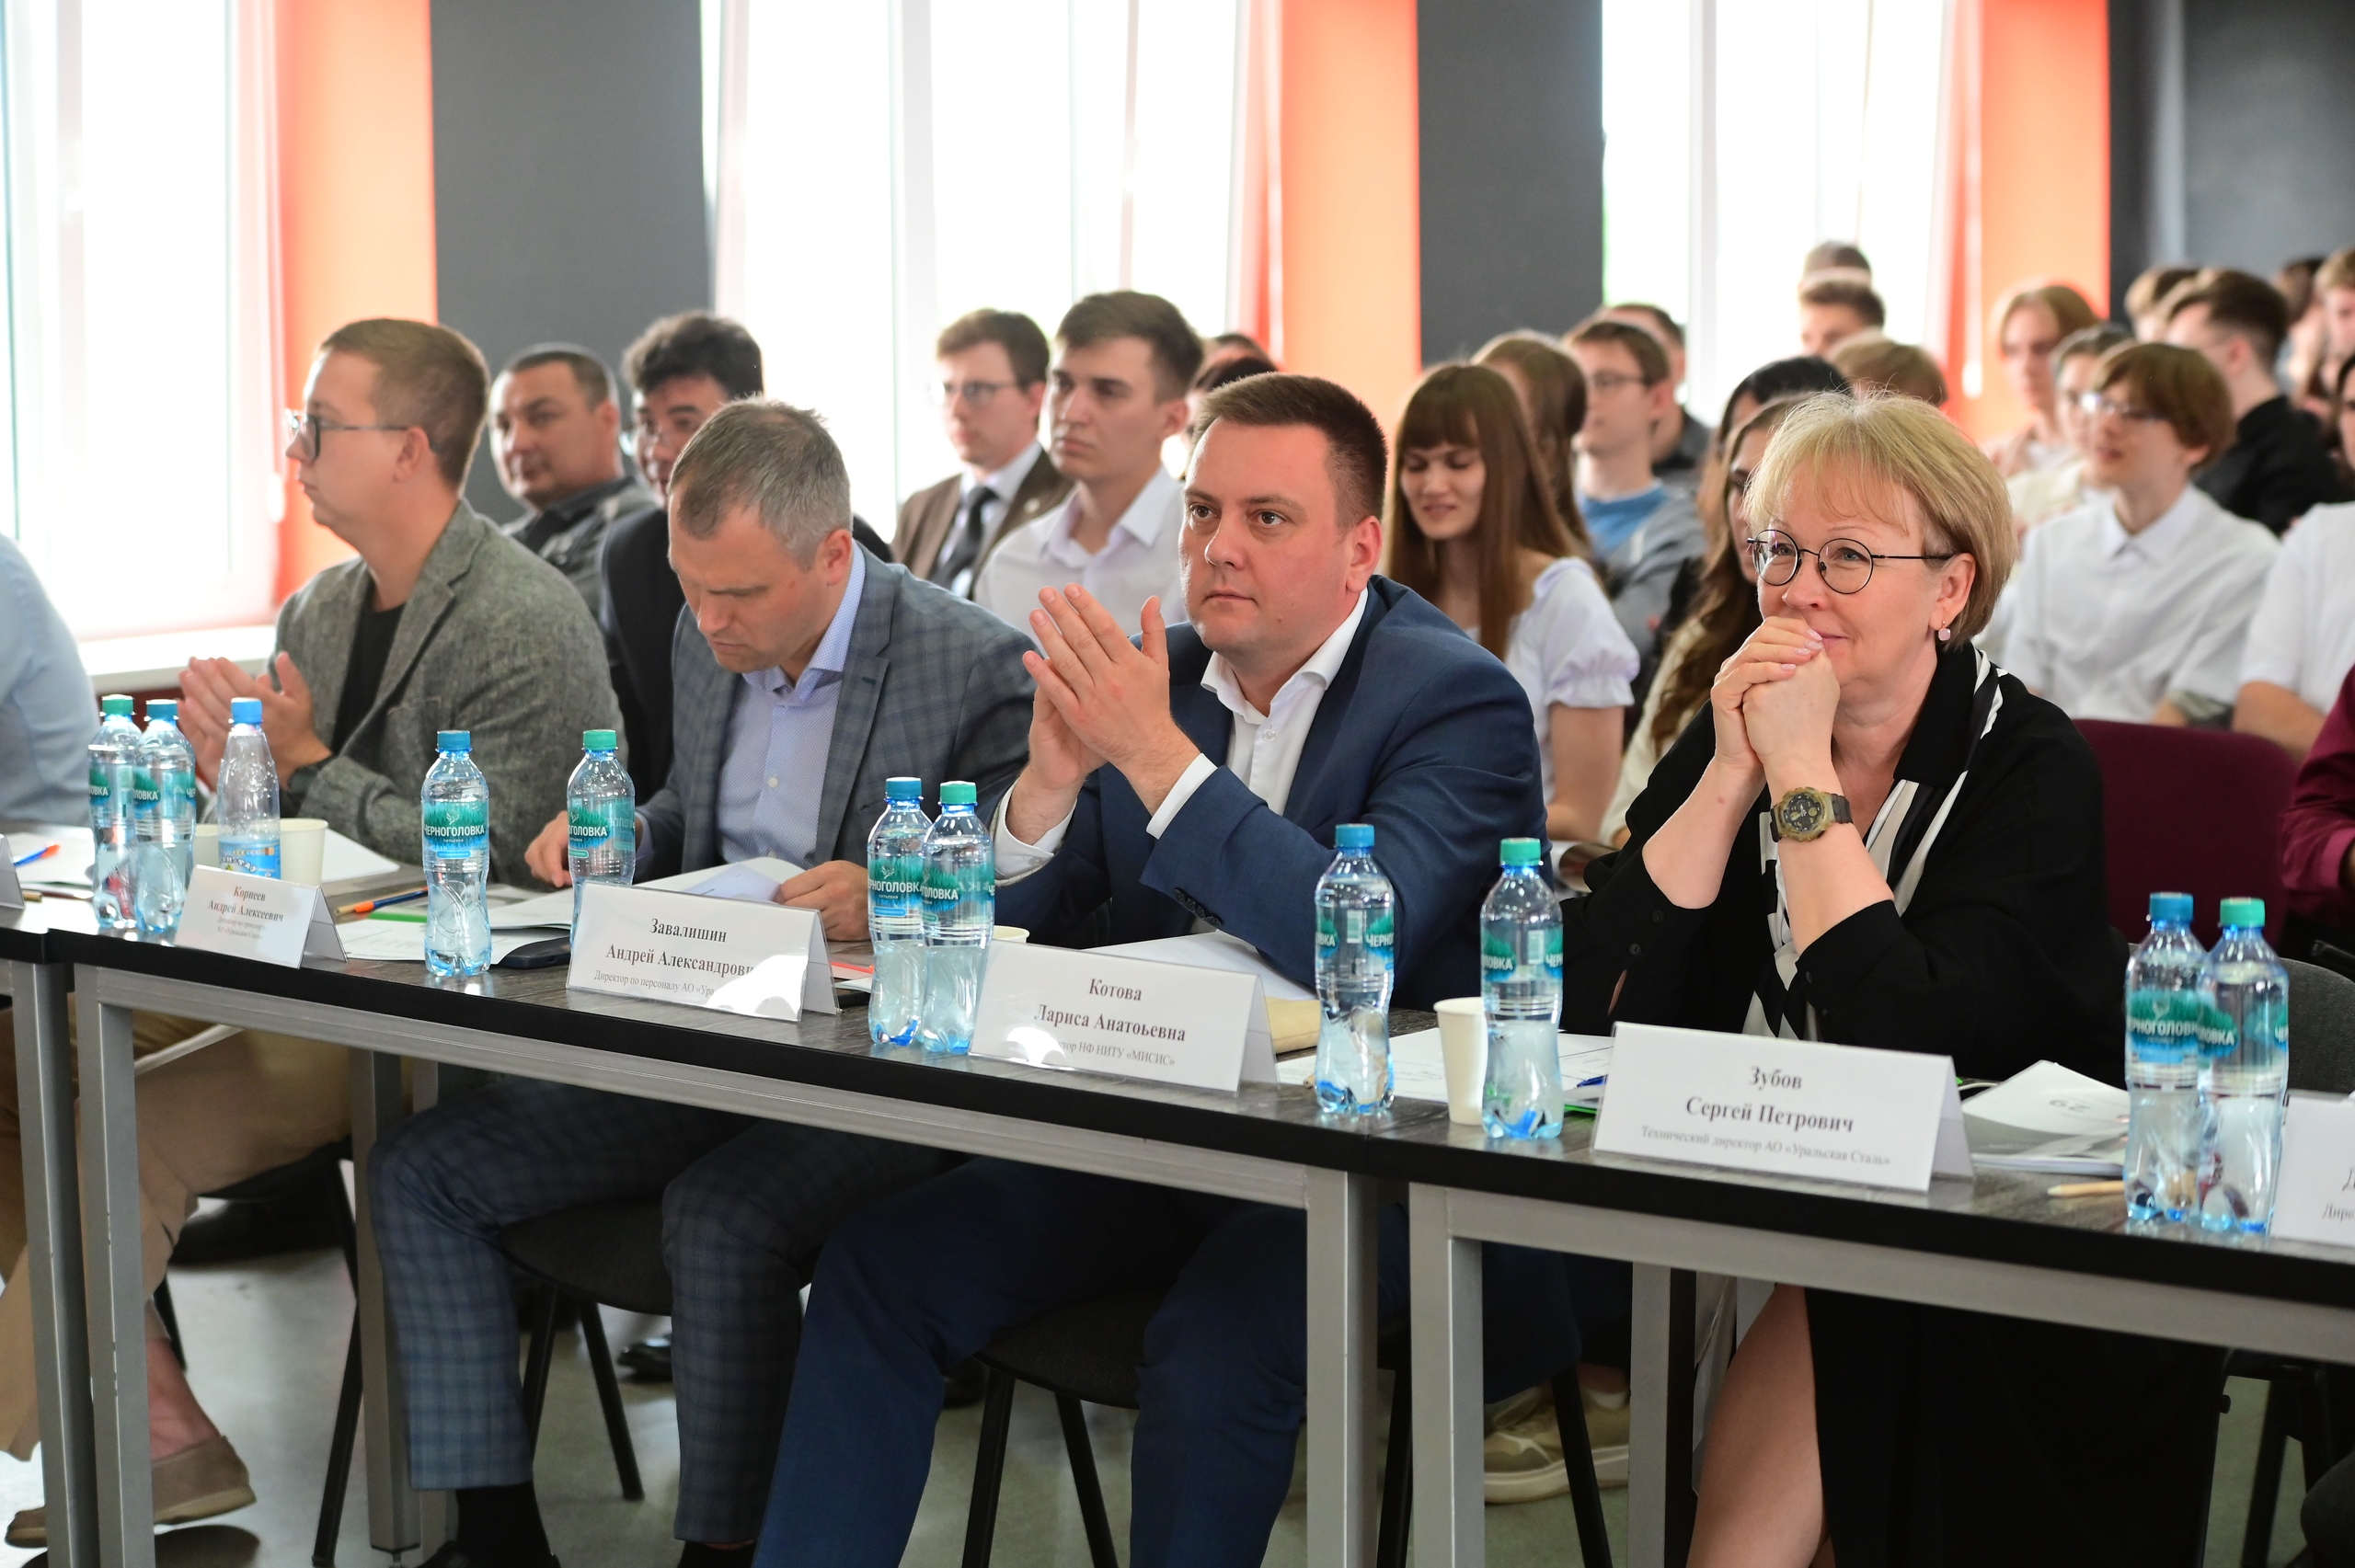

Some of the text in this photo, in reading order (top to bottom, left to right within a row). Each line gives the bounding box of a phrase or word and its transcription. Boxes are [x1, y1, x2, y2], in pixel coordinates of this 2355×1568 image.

[424, 824, 485, 837] ЧЕРНОГОЛОВКА
[234, 887, 266, 901] Корнеев
[208, 900, 284, 921] Андрей Алексеевич
[649, 918, 727, 943] Завалишин
[606, 944, 755, 978] Андрей Александрови
[594, 969, 629, 986] Директор
[630, 976, 639, 985] по
[640, 977, 680, 993] персоналу
[681, 983, 695, 993] АО
[1088, 979, 1142, 1001] Котова
[1034, 1004, 1186, 1041] Лариса Анатоьевна
[1079, 1042, 1095, 1054] НФ
[1097, 1045, 1125, 1059] НИТУ
[1127, 1050, 1176, 1066] «МИСИС»
[1749, 1066, 1802, 1091] Зубов
[1686, 1095, 1854, 1132] Сергей Петрович
[1642, 1125, 1890, 1166] Технический директор АО «Уральская Сталь»
